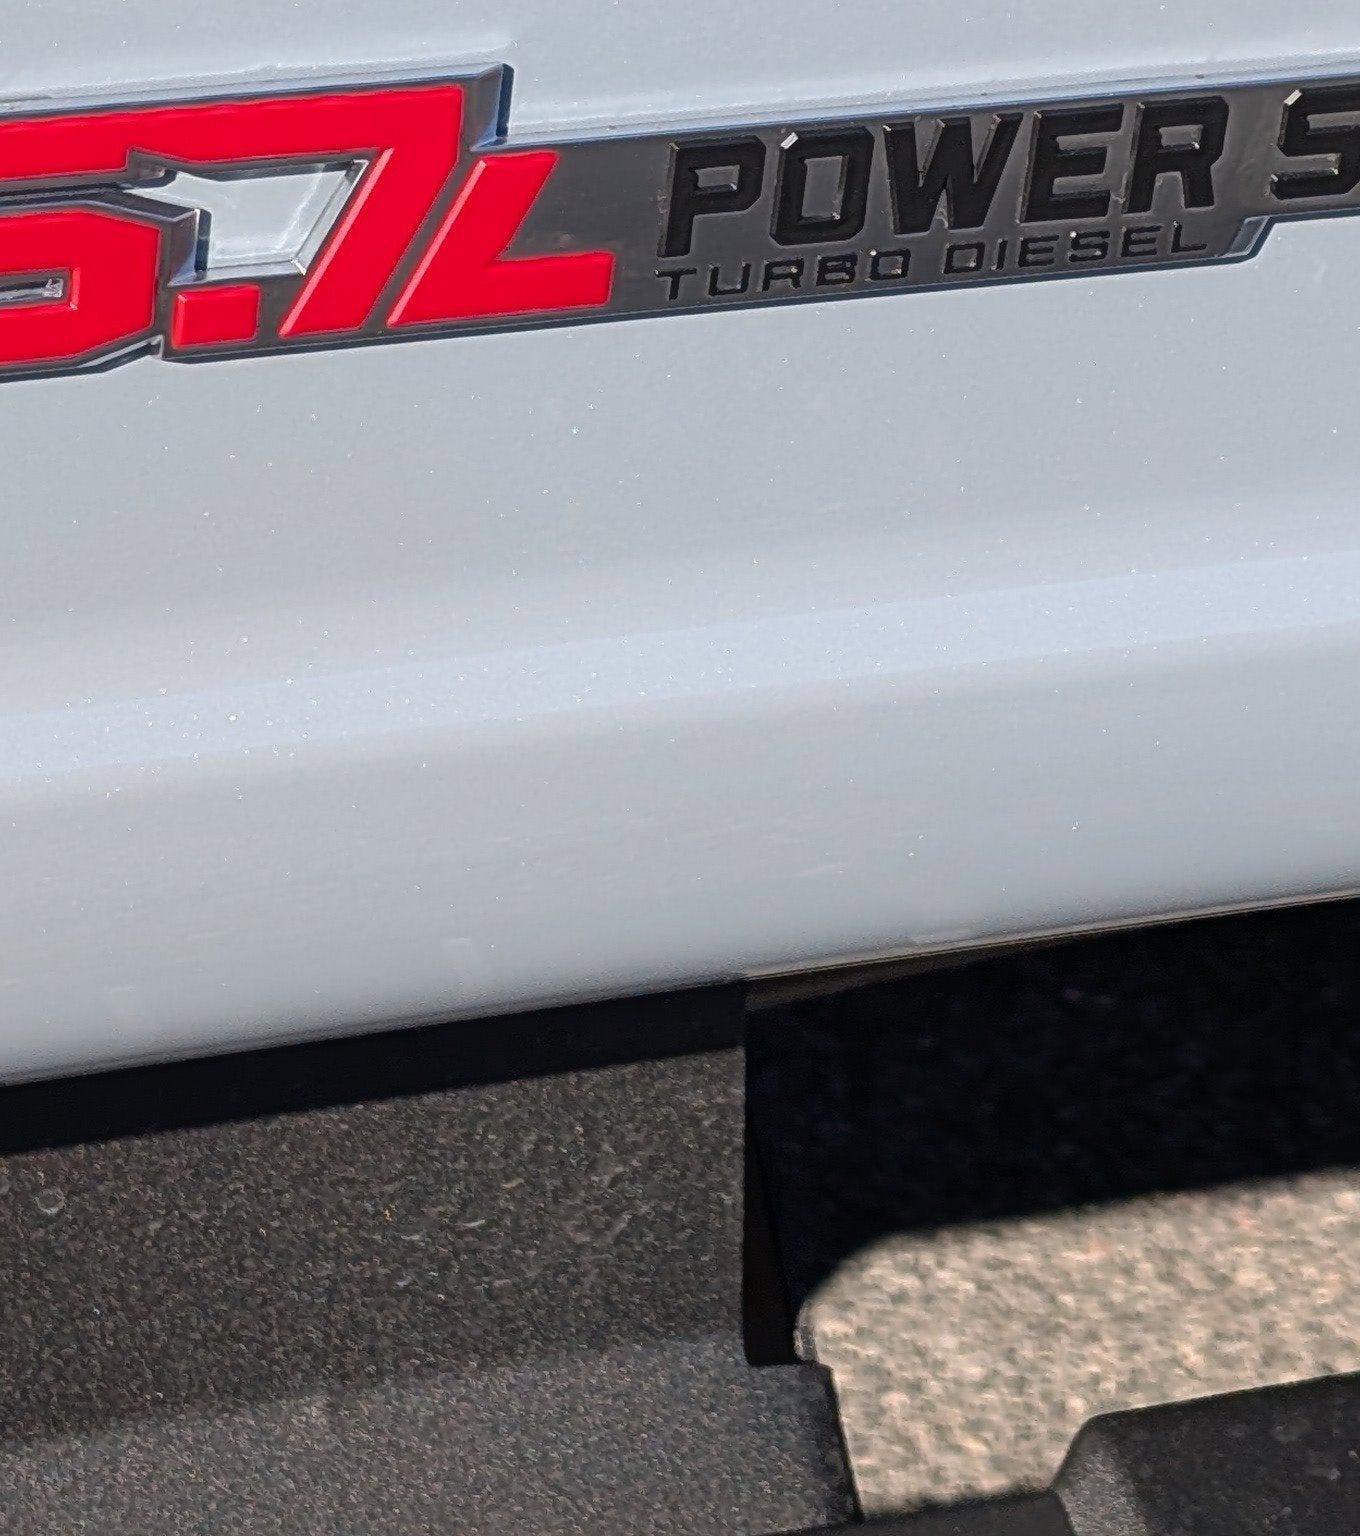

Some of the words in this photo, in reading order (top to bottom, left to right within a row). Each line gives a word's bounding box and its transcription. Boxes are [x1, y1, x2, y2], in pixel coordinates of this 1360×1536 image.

[657, 94, 1228, 257] POWER
[655, 249, 909, 302] TURBO
[943, 220, 1208, 275] DIESEL
